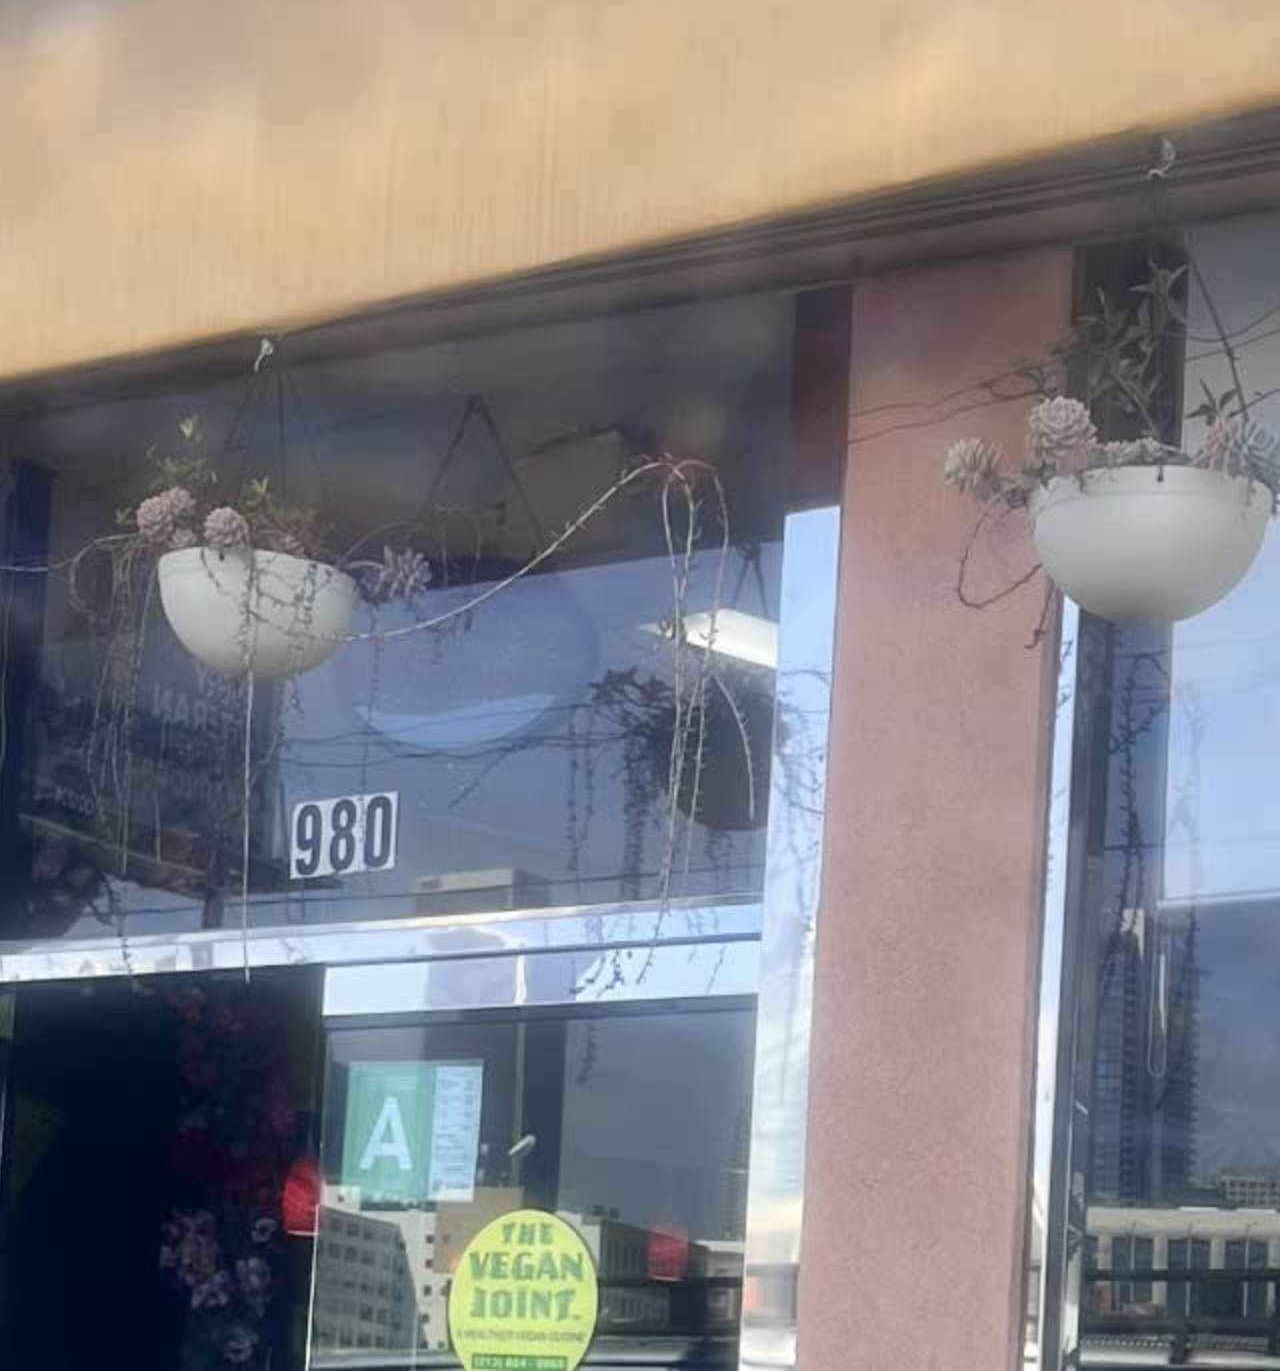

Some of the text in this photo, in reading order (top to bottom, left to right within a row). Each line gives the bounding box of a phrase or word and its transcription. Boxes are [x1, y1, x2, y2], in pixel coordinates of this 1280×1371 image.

[294, 793, 393, 877] 980
[358, 1095, 413, 1171] A
[502, 1221, 554, 1246] THE
[469, 1250, 584, 1282] VEGAN
